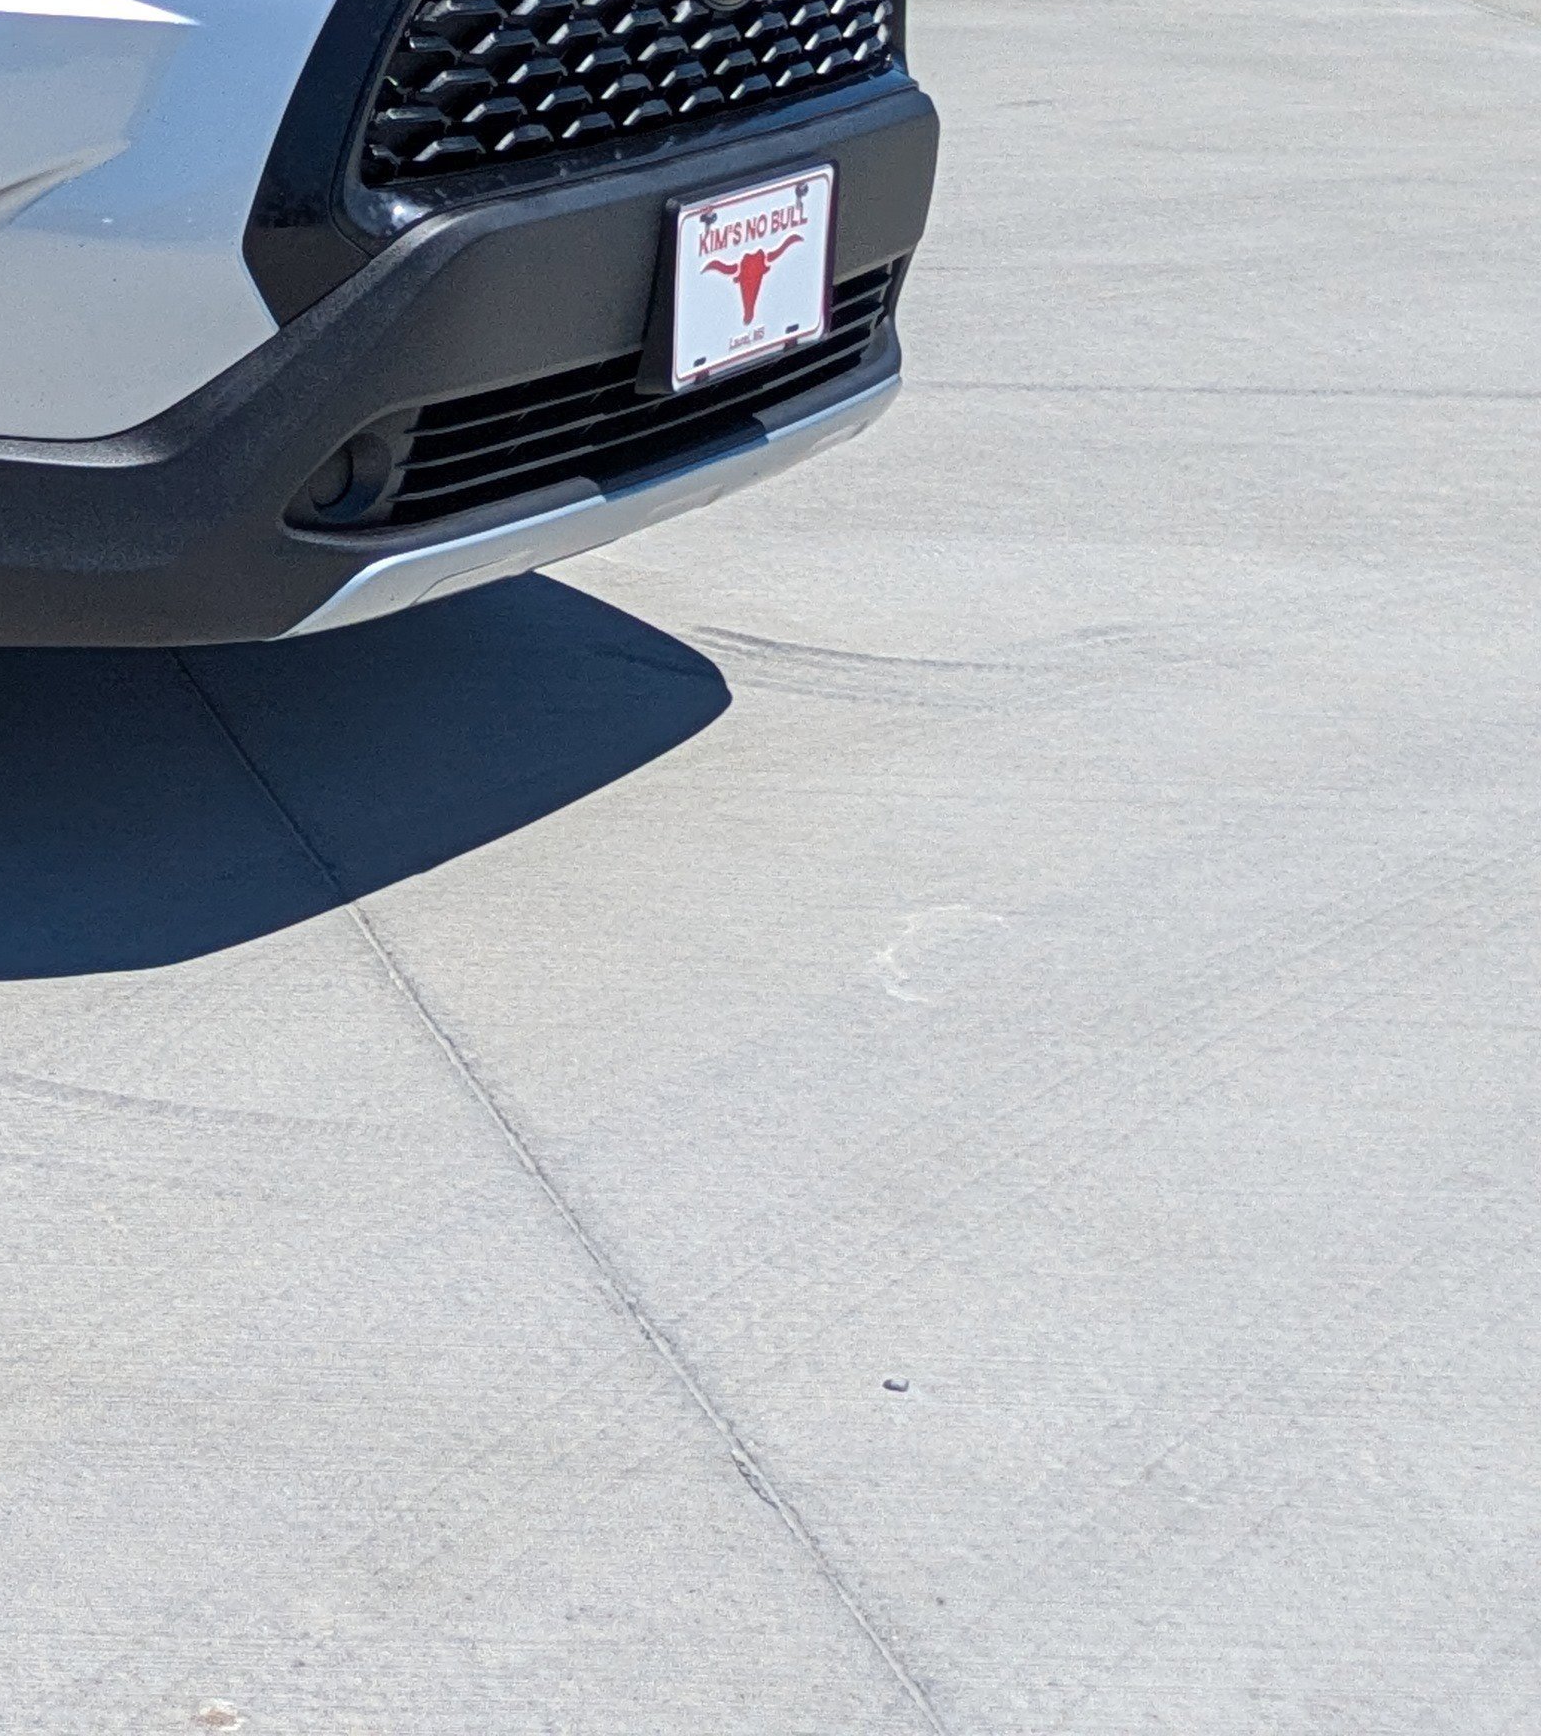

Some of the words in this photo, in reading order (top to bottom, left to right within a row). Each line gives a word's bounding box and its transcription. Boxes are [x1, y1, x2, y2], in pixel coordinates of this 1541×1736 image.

[698, 220, 743, 257] KIM'S
[745, 212, 767, 243] NO
[771, 203, 808, 235] BULL
